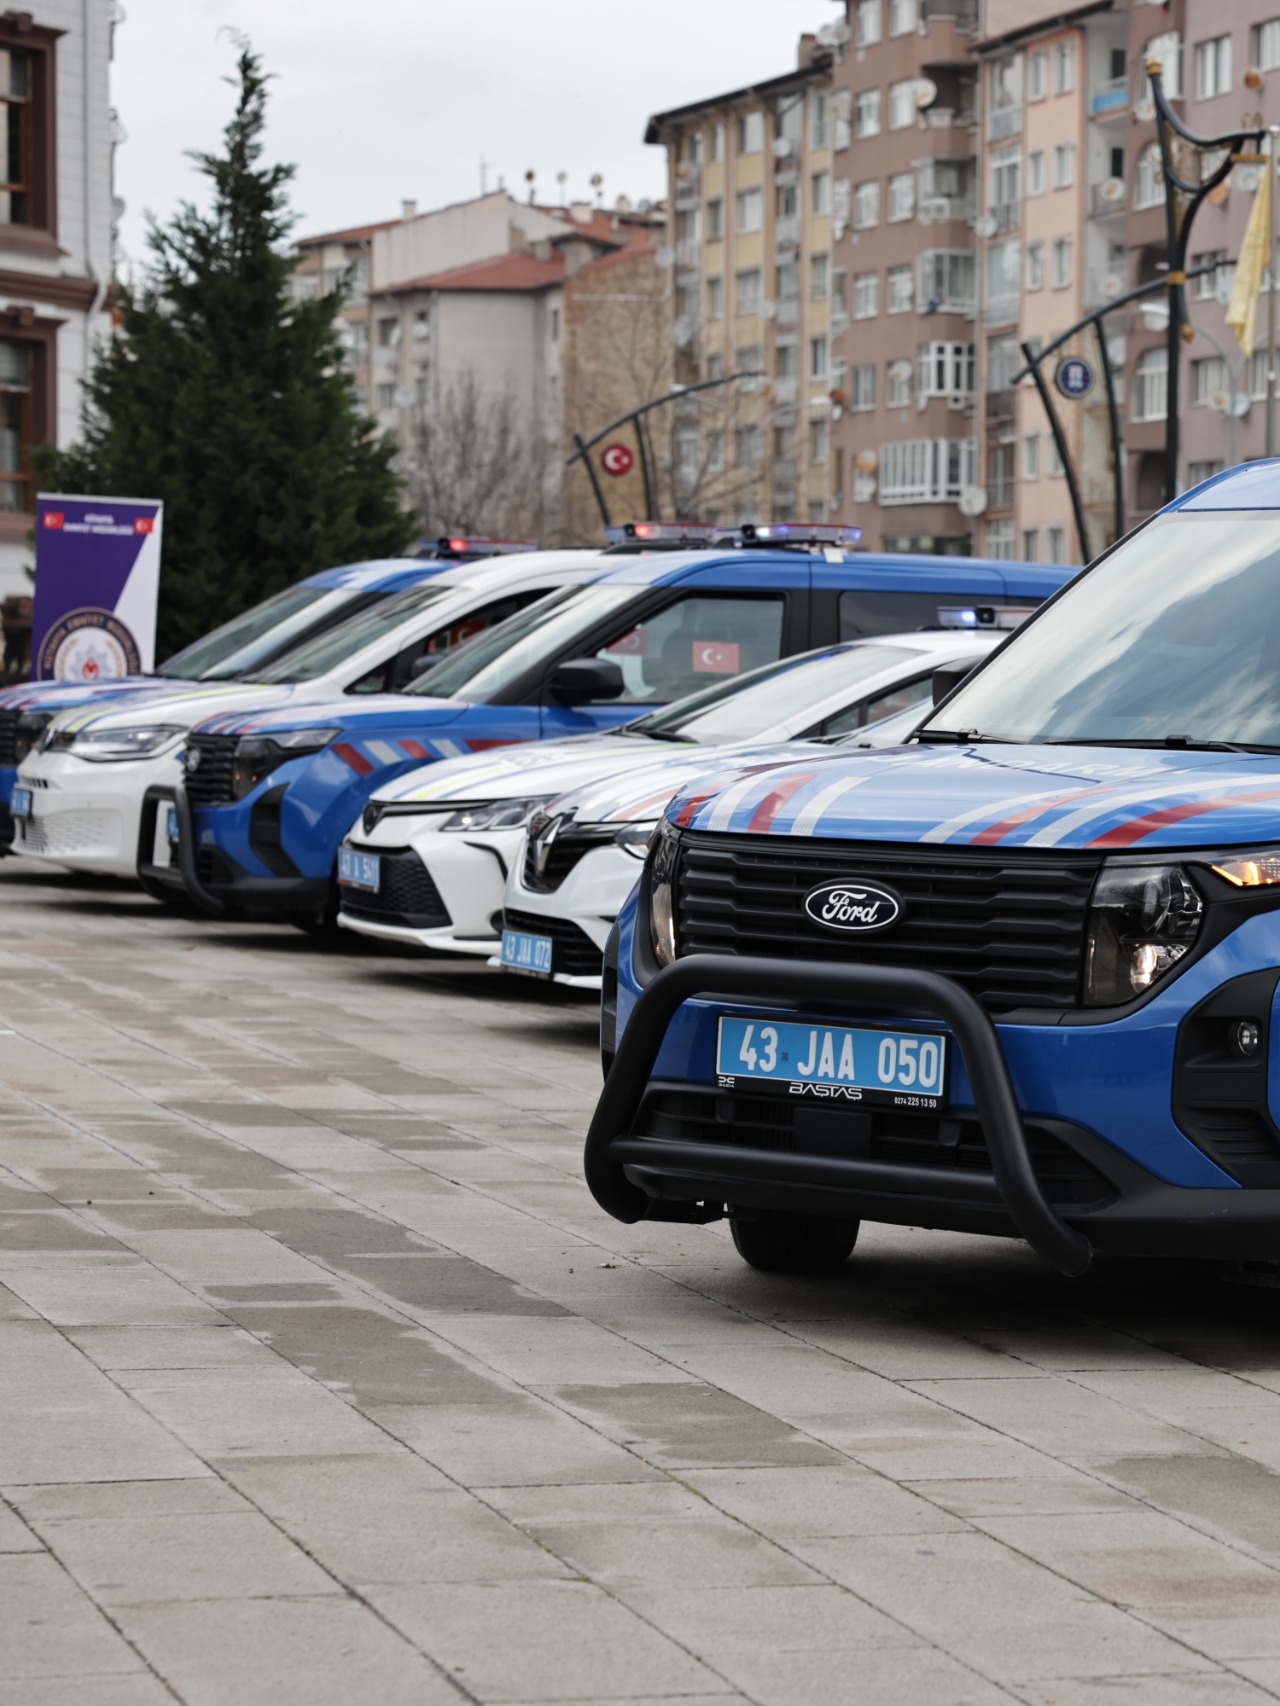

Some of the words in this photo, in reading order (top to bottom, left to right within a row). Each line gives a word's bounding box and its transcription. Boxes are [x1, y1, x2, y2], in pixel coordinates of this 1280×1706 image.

[822, 890, 881, 924] Ford
[739, 1024, 778, 1073] 43
[797, 1030, 855, 1081] JAA
[877, 1037, 938, 1089] 050
[907, 1096, 920, 1106] 225
[920, 1098, 929, 1107] 13
[929, 1099, 937, 1108] 50
